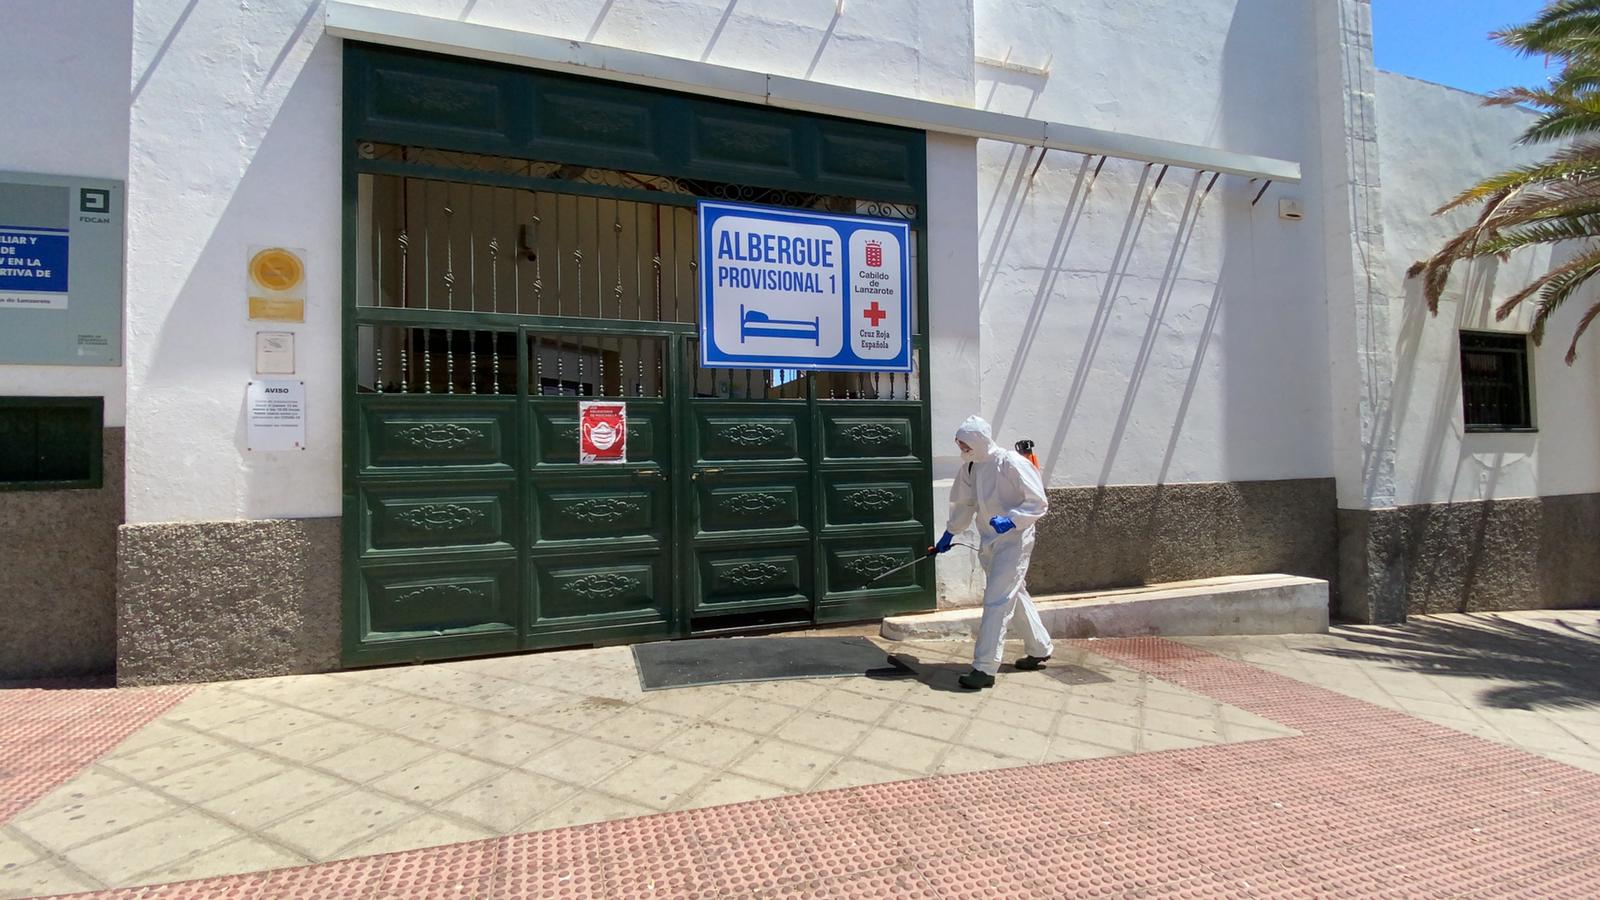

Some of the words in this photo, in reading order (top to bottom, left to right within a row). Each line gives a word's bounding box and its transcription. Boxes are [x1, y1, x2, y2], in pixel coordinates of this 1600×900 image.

[30, 237, 37, 245] Y
[1, 246, 16, 255] DE
[718, 230, 834, 268] ALBERGUE
[8, 257, 24, 266] EN
[27, 258, 42, 267] LA
[36, 269, 52, 278] DE
[859, 270, 890, 280] Cabildo
[718, 266, 824, 293] PROVISIONAL
[829, 274, 836, 294] 1
[855, 285, 894, 295] Lanzarote
[859, 329, 875, 338] Cruz
[876, 330, 890, 340] Roja
[861, 340, 889, 350] Española
